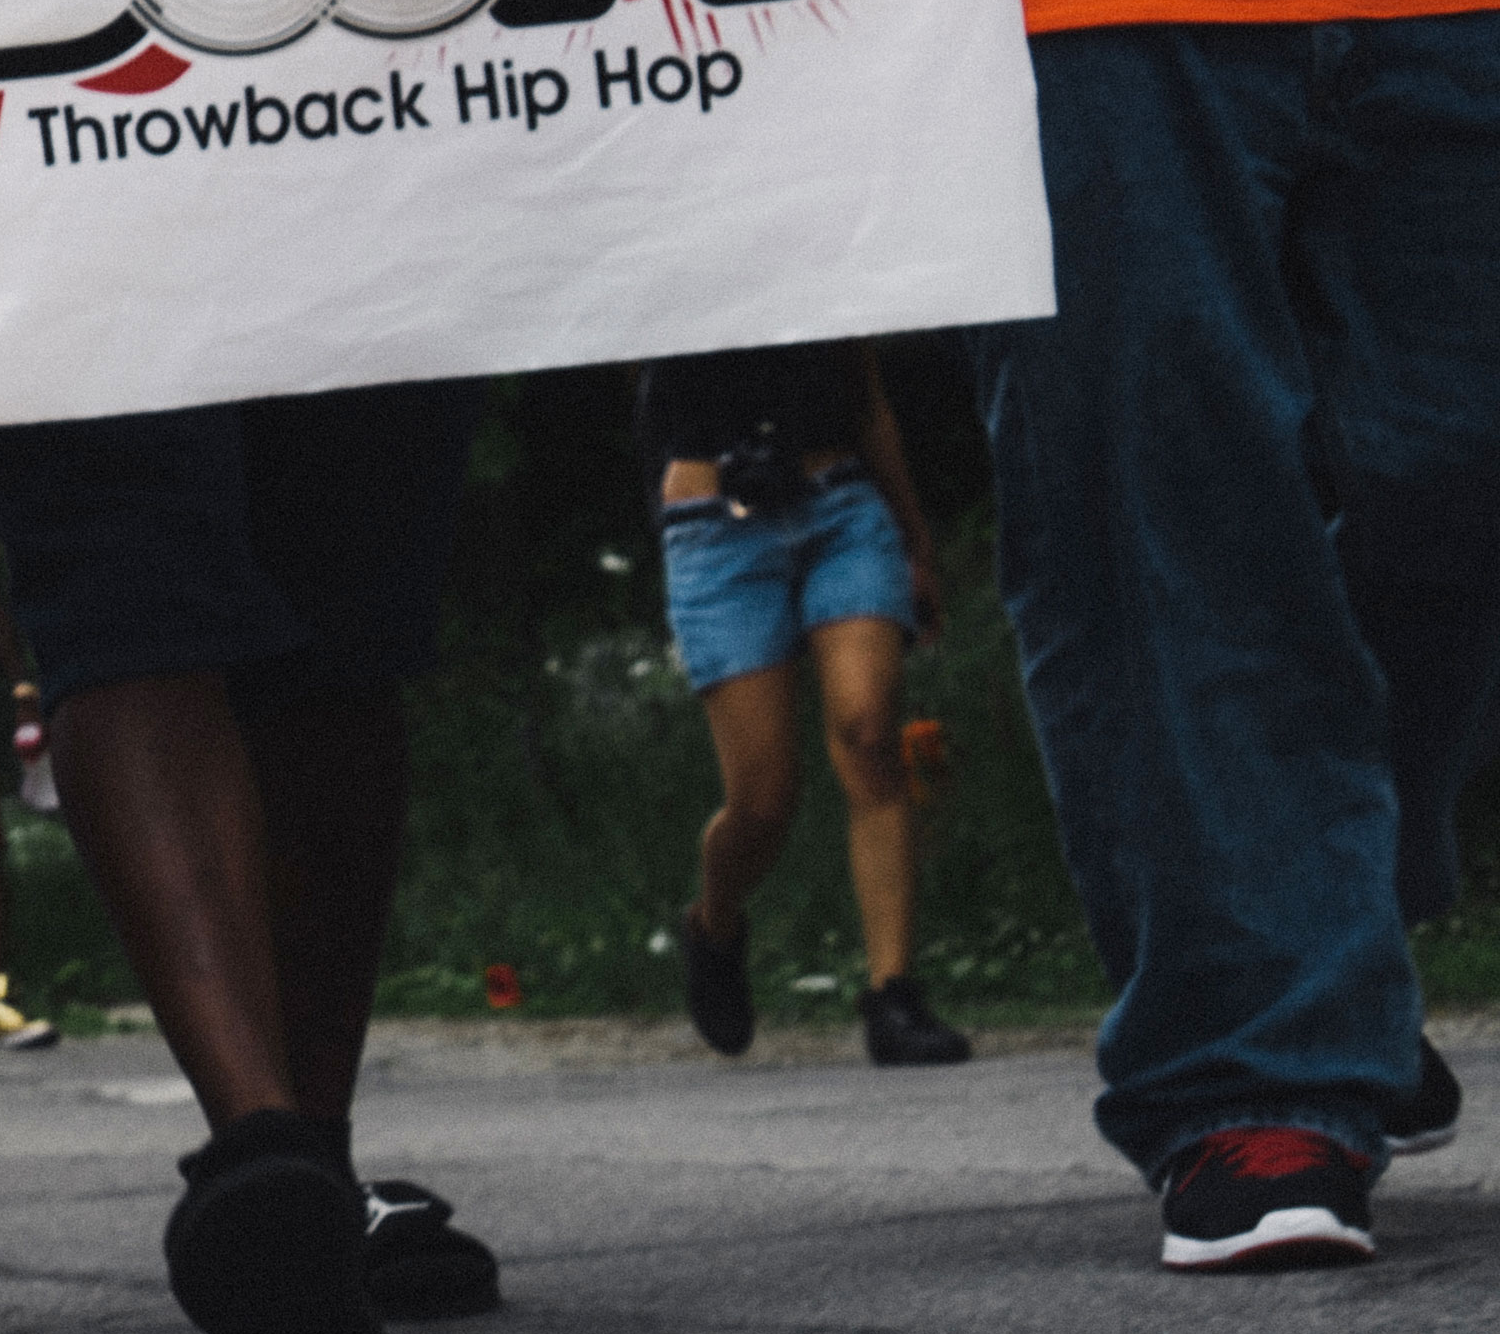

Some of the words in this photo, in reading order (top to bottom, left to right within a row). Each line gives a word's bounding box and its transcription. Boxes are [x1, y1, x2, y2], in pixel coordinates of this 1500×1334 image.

[27, 69, 433, 168] Throwback
[451, 57, 572, 131] Hip
[591, 42, 746, 114] Hop
